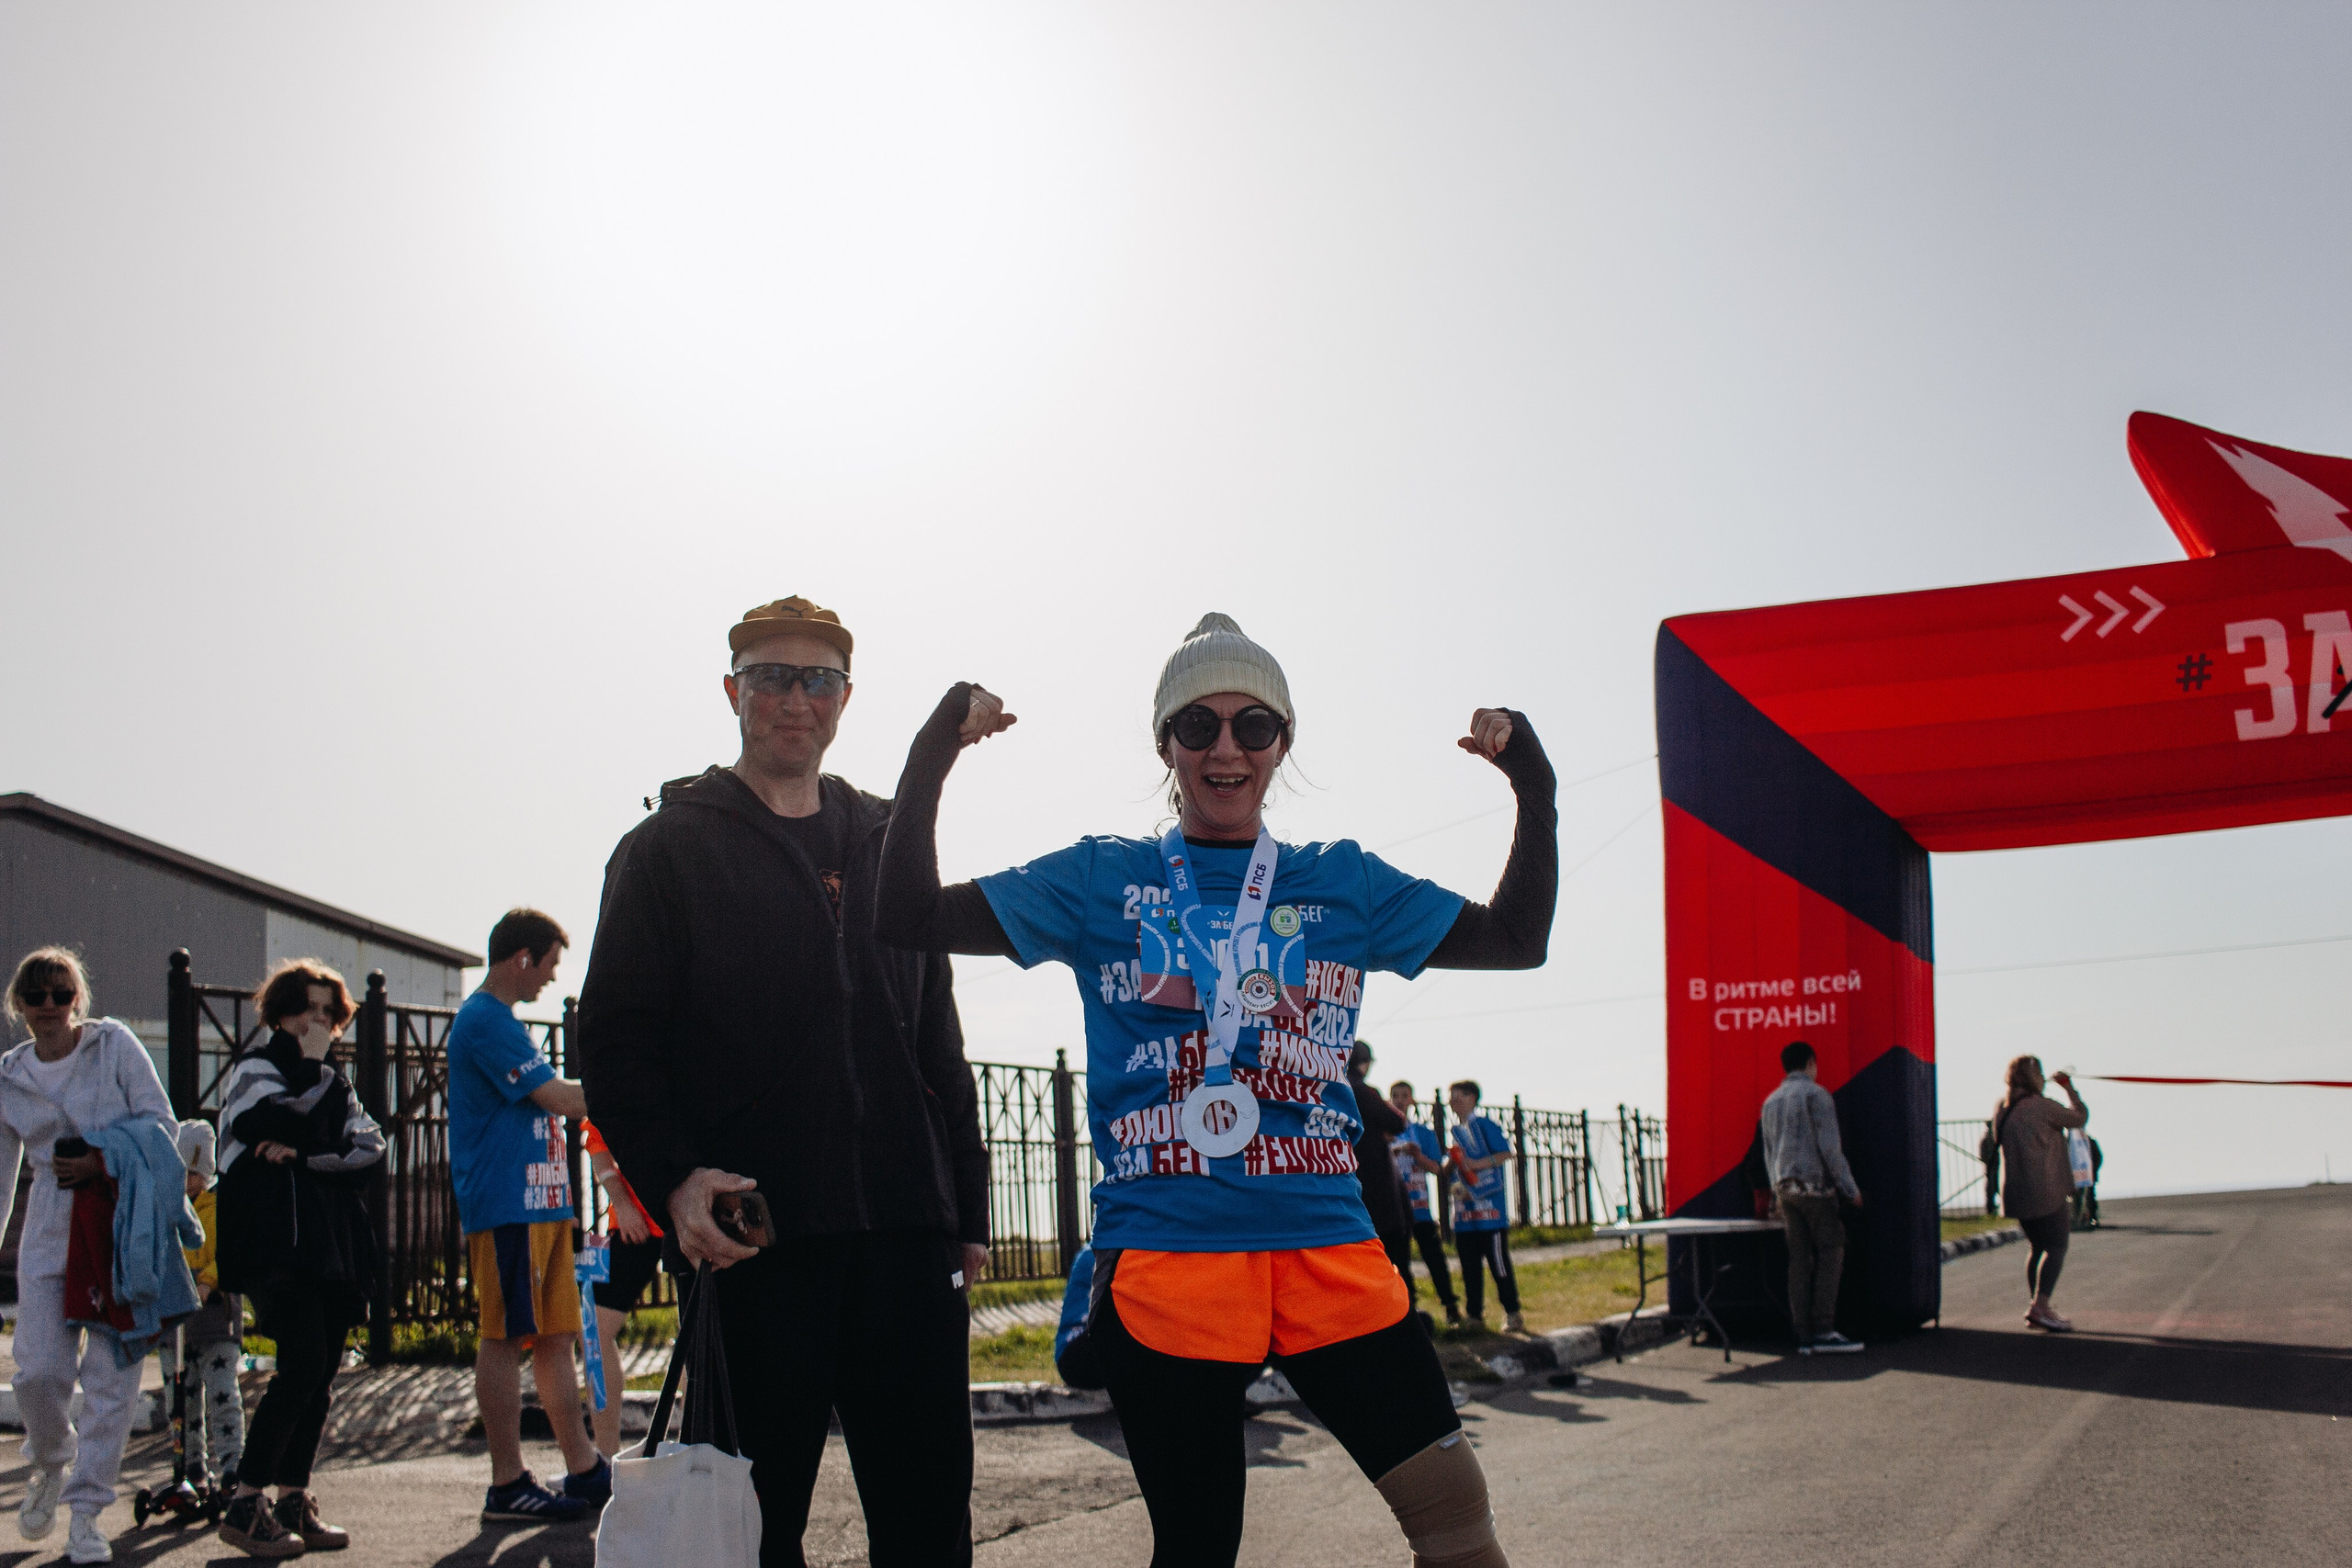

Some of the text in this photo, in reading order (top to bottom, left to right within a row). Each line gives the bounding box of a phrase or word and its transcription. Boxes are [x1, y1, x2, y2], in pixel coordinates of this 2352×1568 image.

[1173, 868, 1189, 891] ПСБ
[1252, 863, 1267, 886] ПСБ
[1259, 974, 1276, 994] ВЫЗОВ
[1305, 959, 1361, 1009] #ЦЕЛЬ
[1689, 968, 1862, 1003] В ритме всей
[1312, 1002, 1360, 1047] 202
[1713, 1002, 1837, 1032] СТРАНЫ!
[1258, 1028, 1352, 1086] #МОМЕ
